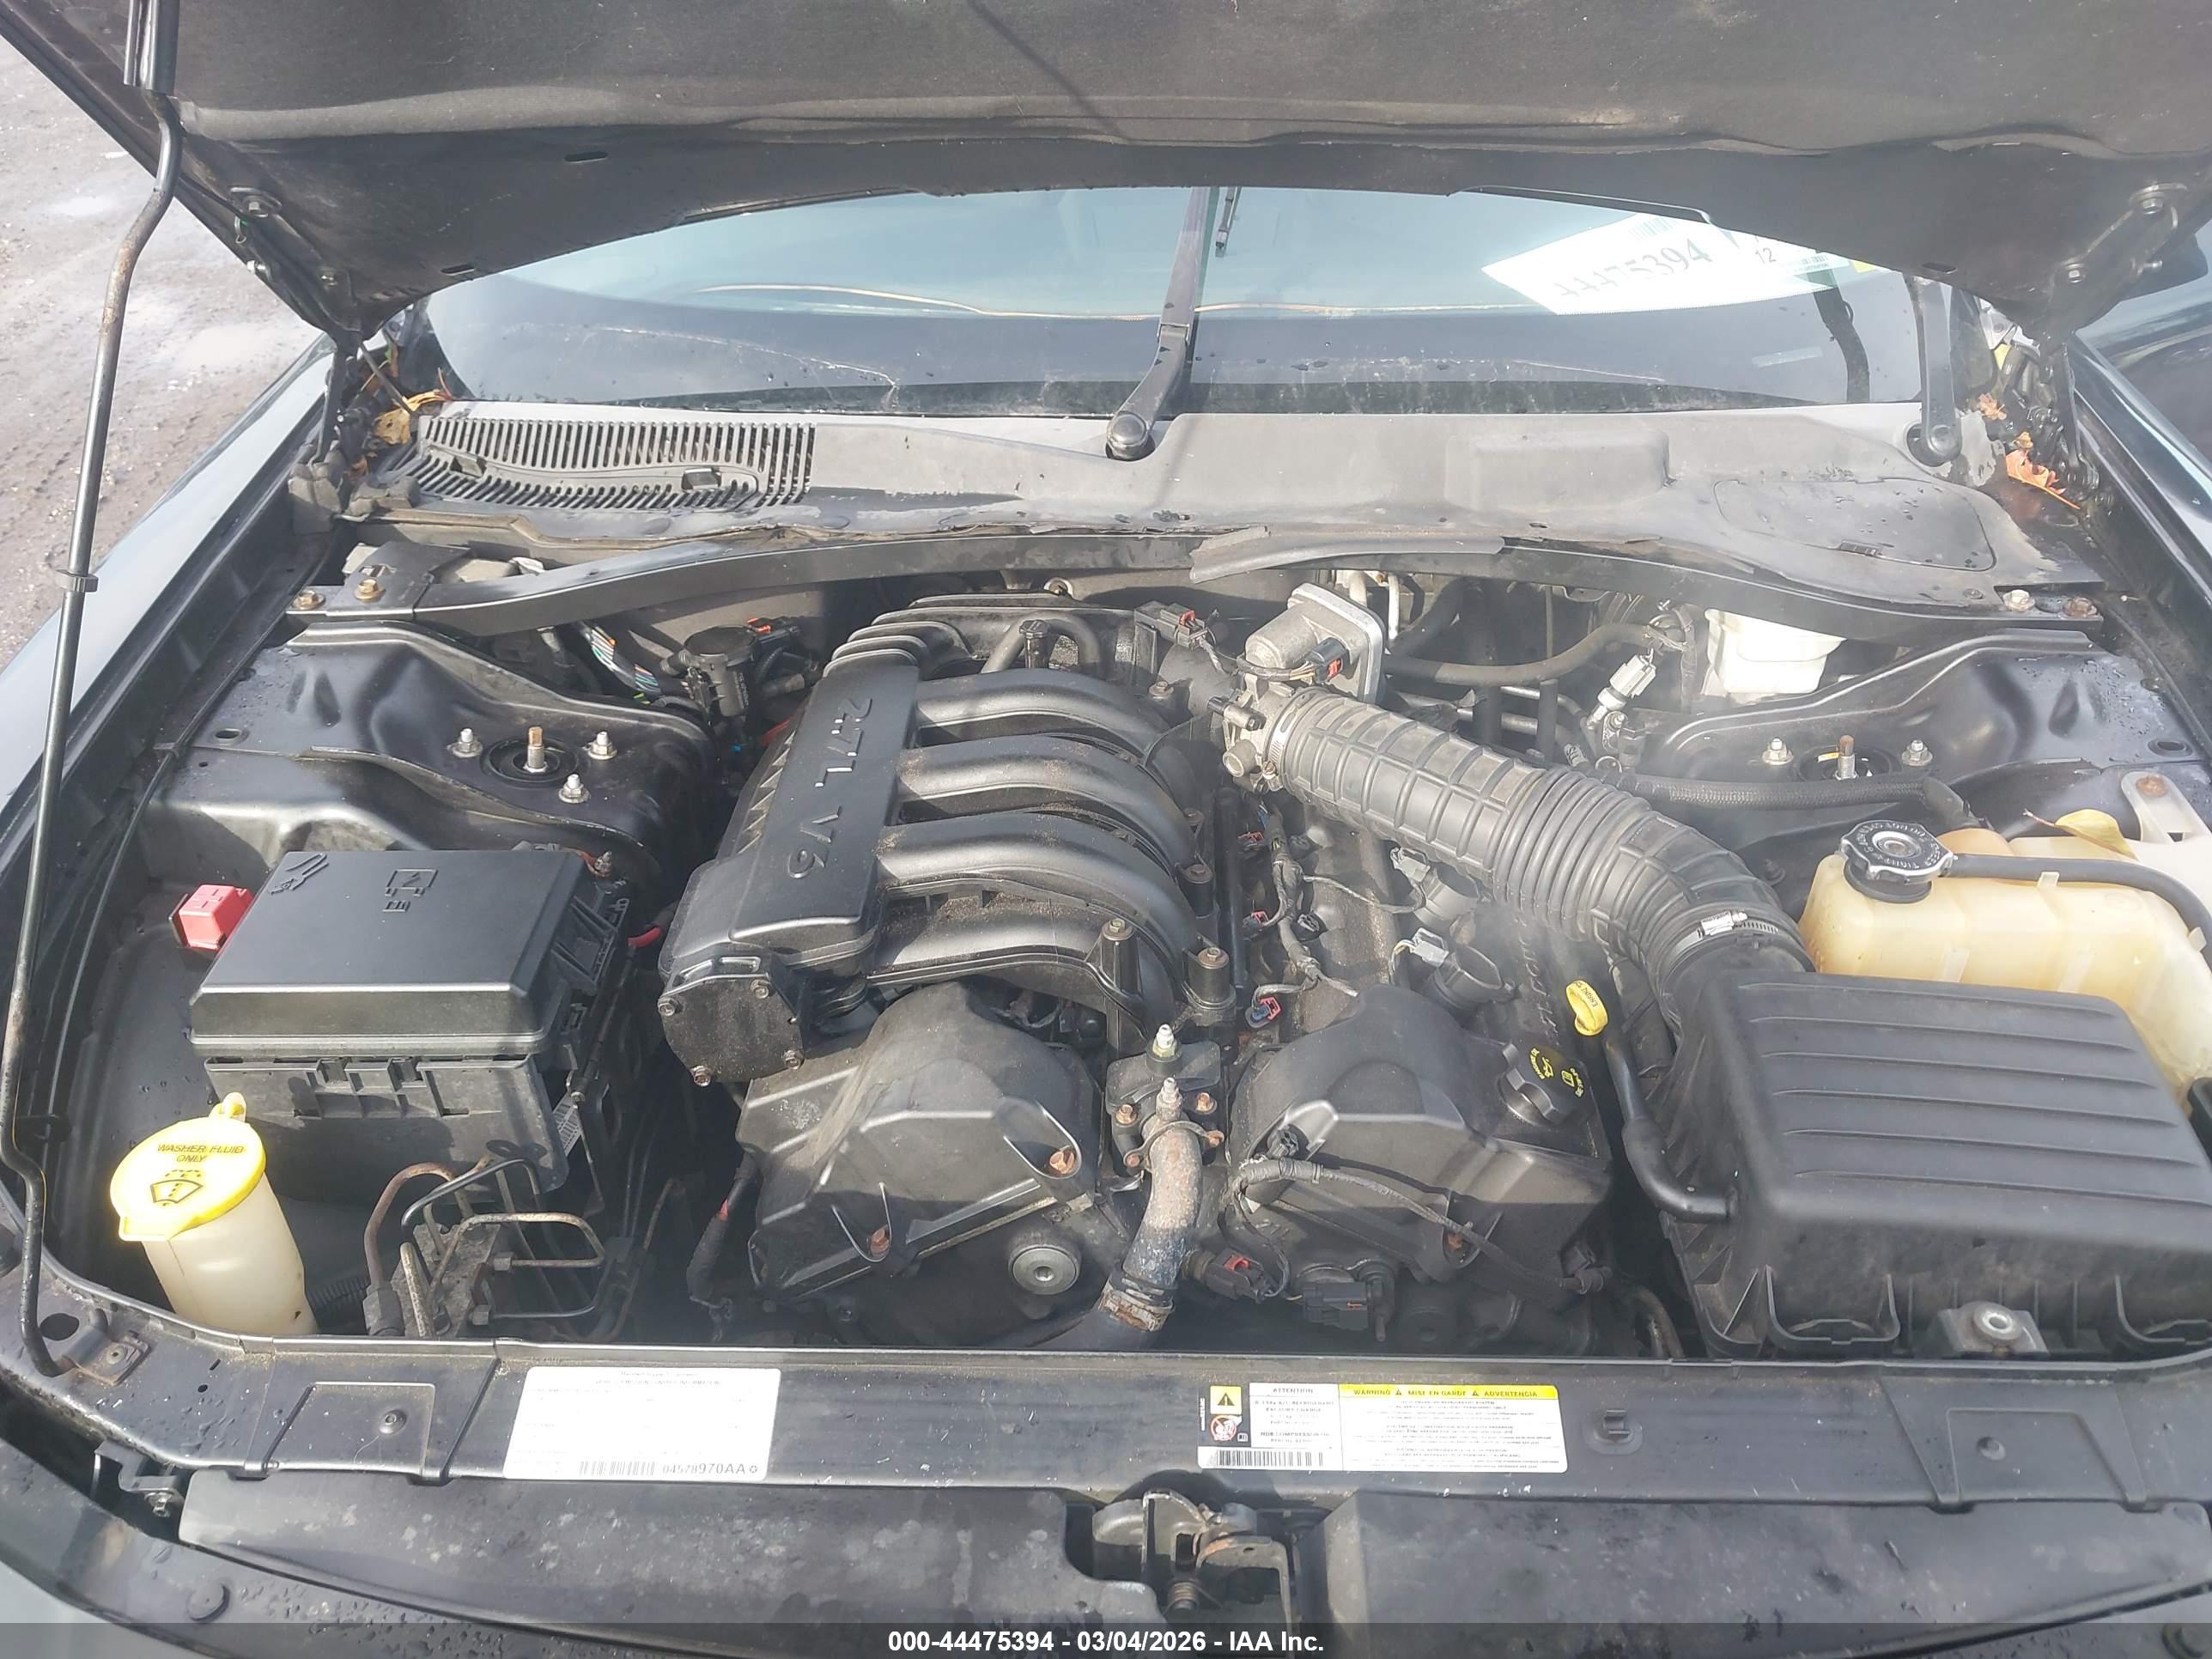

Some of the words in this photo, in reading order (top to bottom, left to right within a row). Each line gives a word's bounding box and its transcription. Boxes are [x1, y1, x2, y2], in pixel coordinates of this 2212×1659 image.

[787, 805, 843, 879] V6
[157, 1144, 207, 1153] WASHER
[176, 1154, 208, 1163] ONLY
